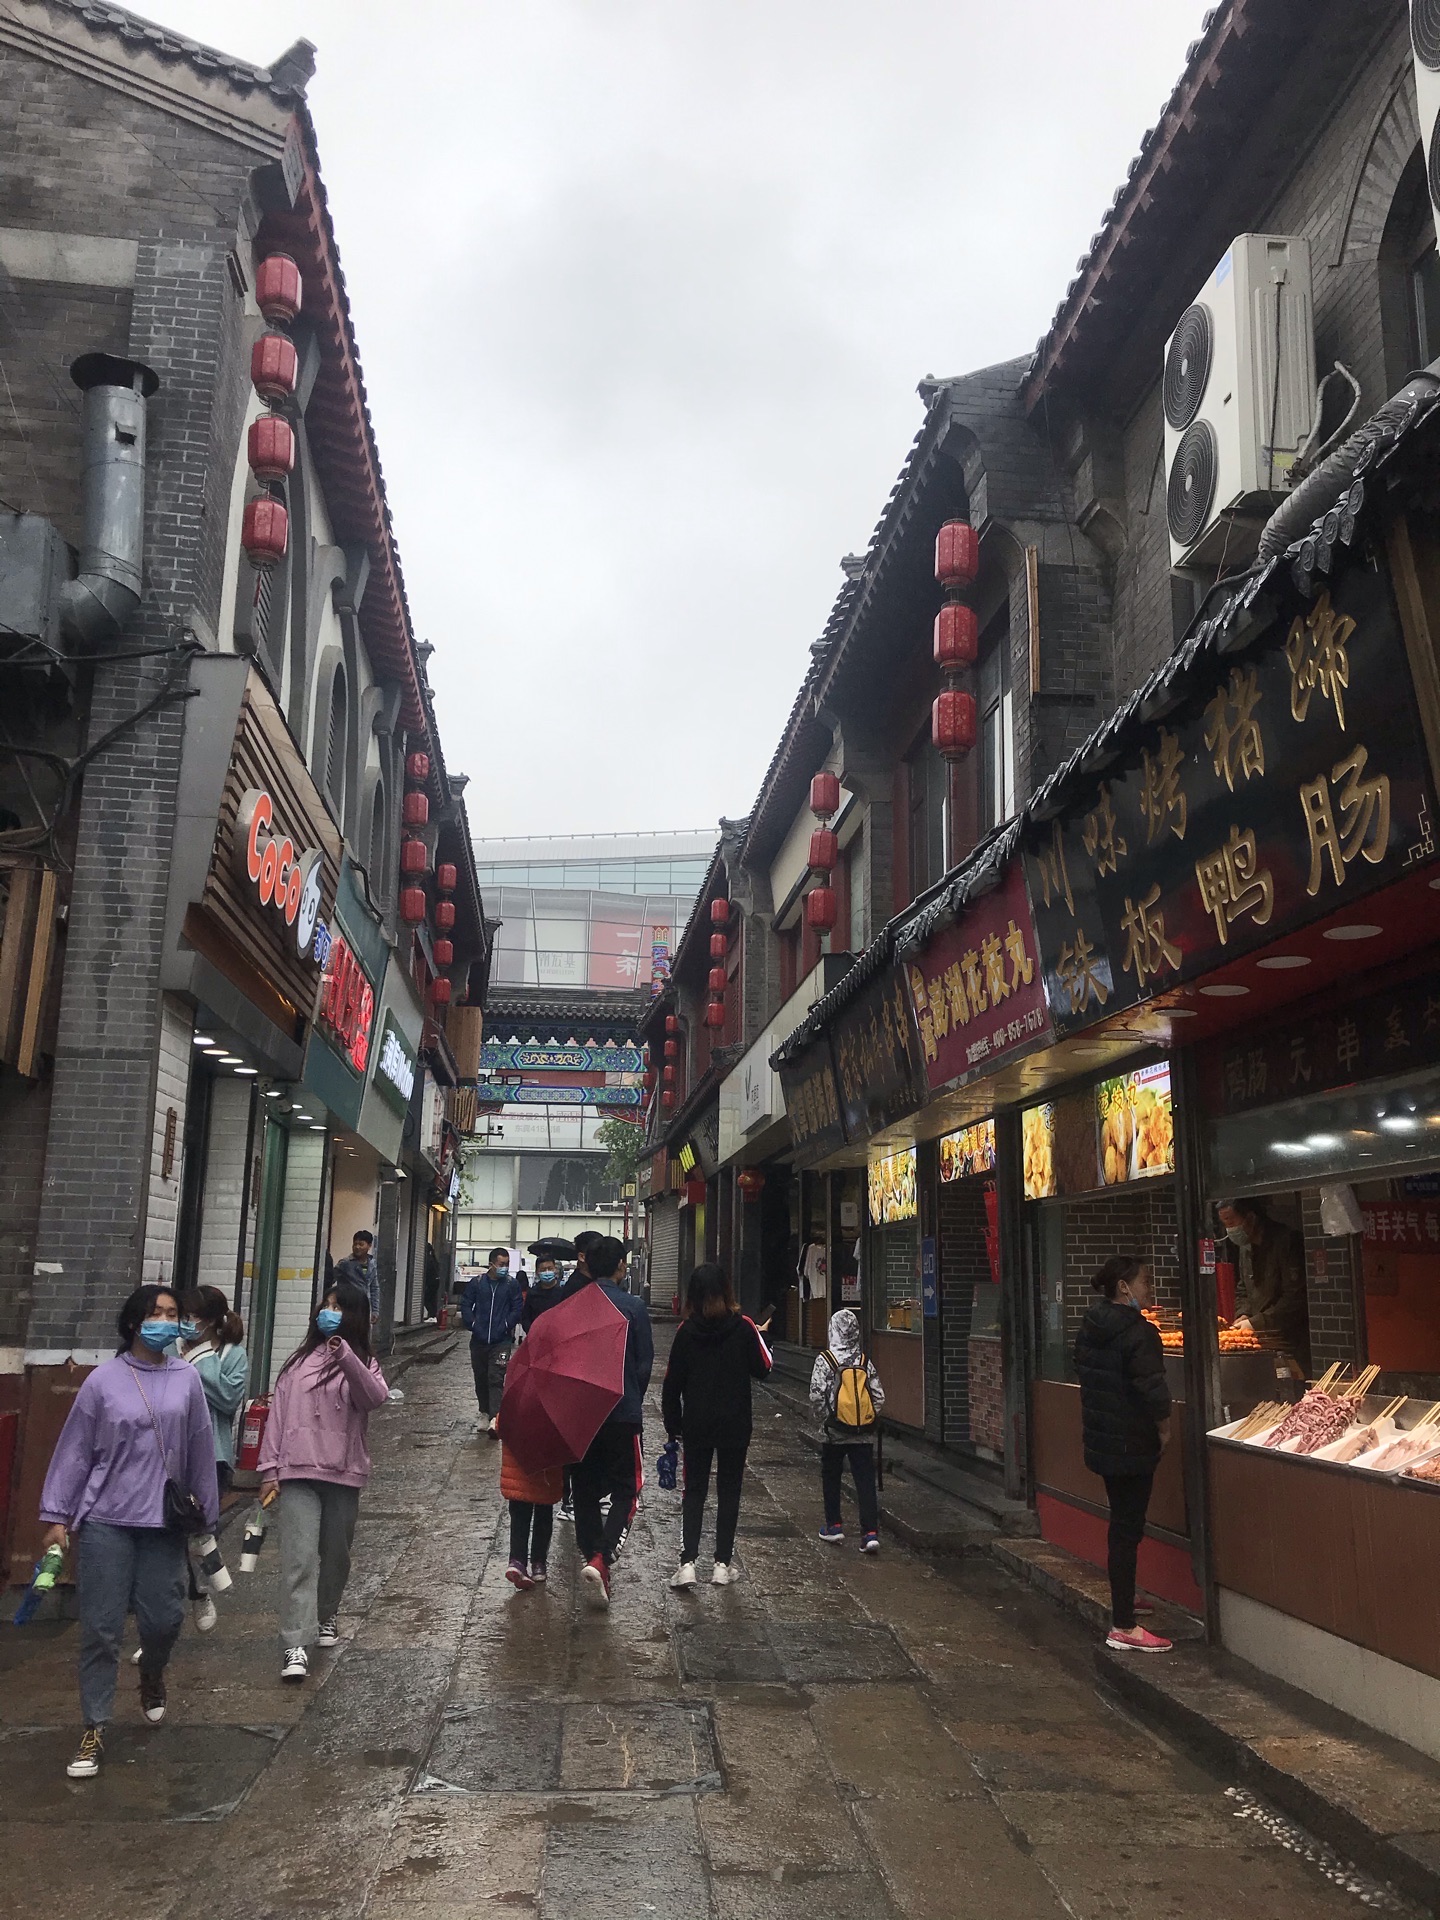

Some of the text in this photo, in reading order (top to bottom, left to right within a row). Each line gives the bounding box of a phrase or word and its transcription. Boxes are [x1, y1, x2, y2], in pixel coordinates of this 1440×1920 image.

[1037, 591, 1356, 917] 川味烤猪蹄
[1055, 744, 1392, 1015] 铁板鸭肠
[928, 919, 1034, 1039] 澎湖花枝丸
[1336, 1016, 1361, 1073] 串
